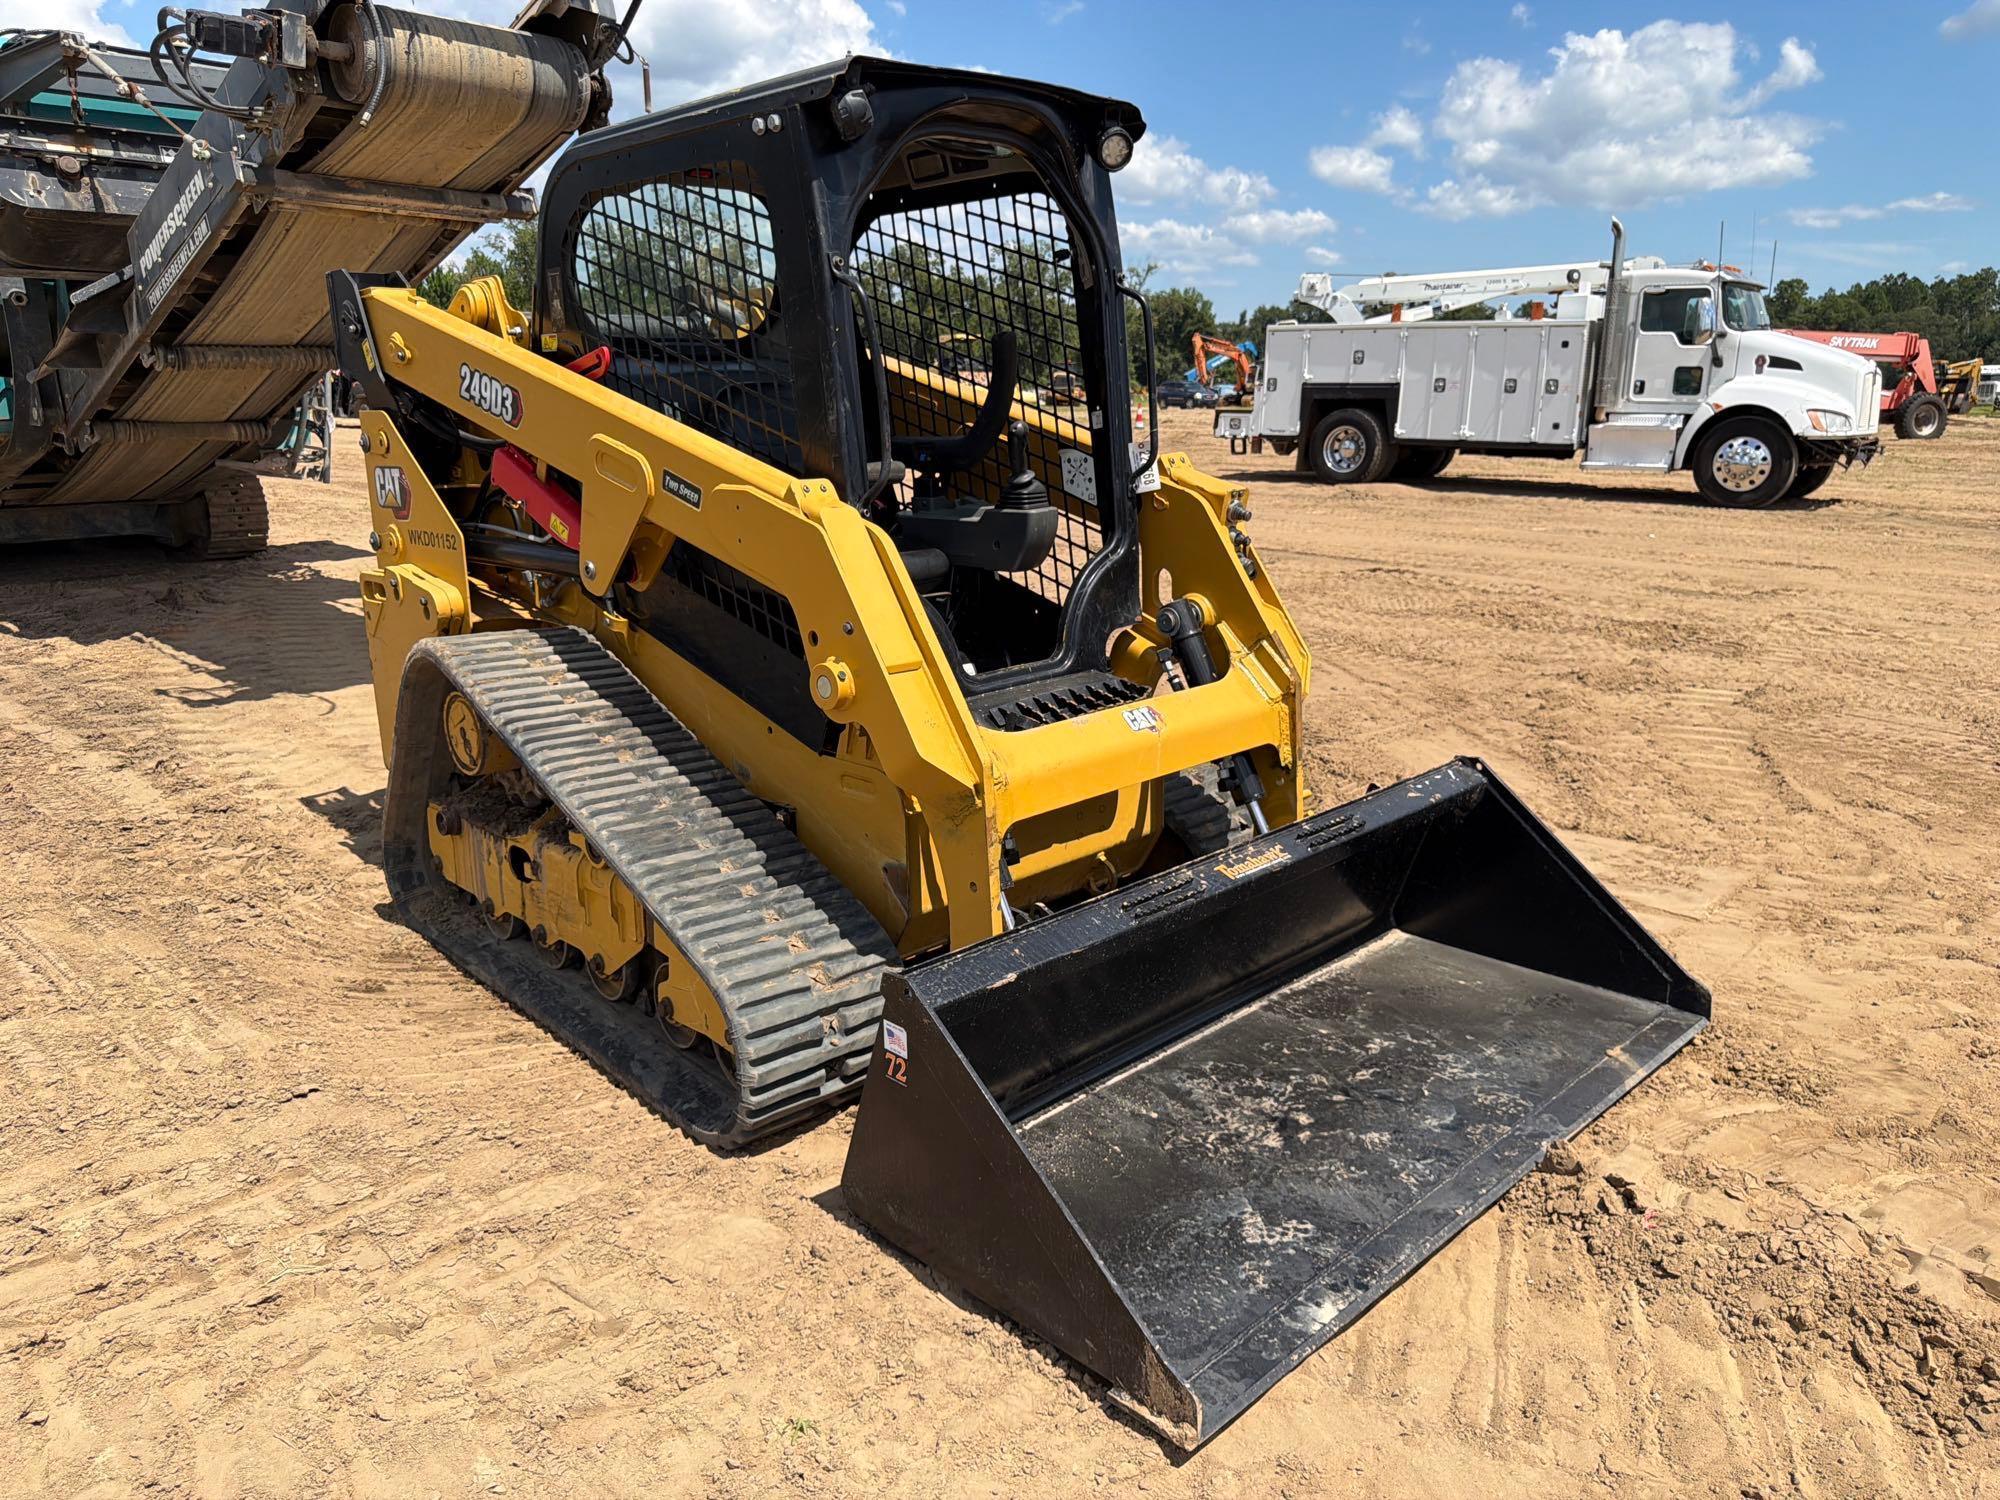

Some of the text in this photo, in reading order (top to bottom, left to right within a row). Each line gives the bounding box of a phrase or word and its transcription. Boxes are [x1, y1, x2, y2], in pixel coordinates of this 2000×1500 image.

[139, 169, 206, 279] POWERSCREEN
[148, 217, 209, 310] POWERSCREENFLA.COM
[1829, 335, 1880, 349] SKYTRAK
[459, 363, 514, 423] 249D3
[374, 466, 402, 508] CAT
[408, 529, 458, 551] WKD01152
[1121, 705, 1158, 732] CAT
[1213, 842, 1290, 880] Tomahawk
[885, 1052, 907, 1083] 72
